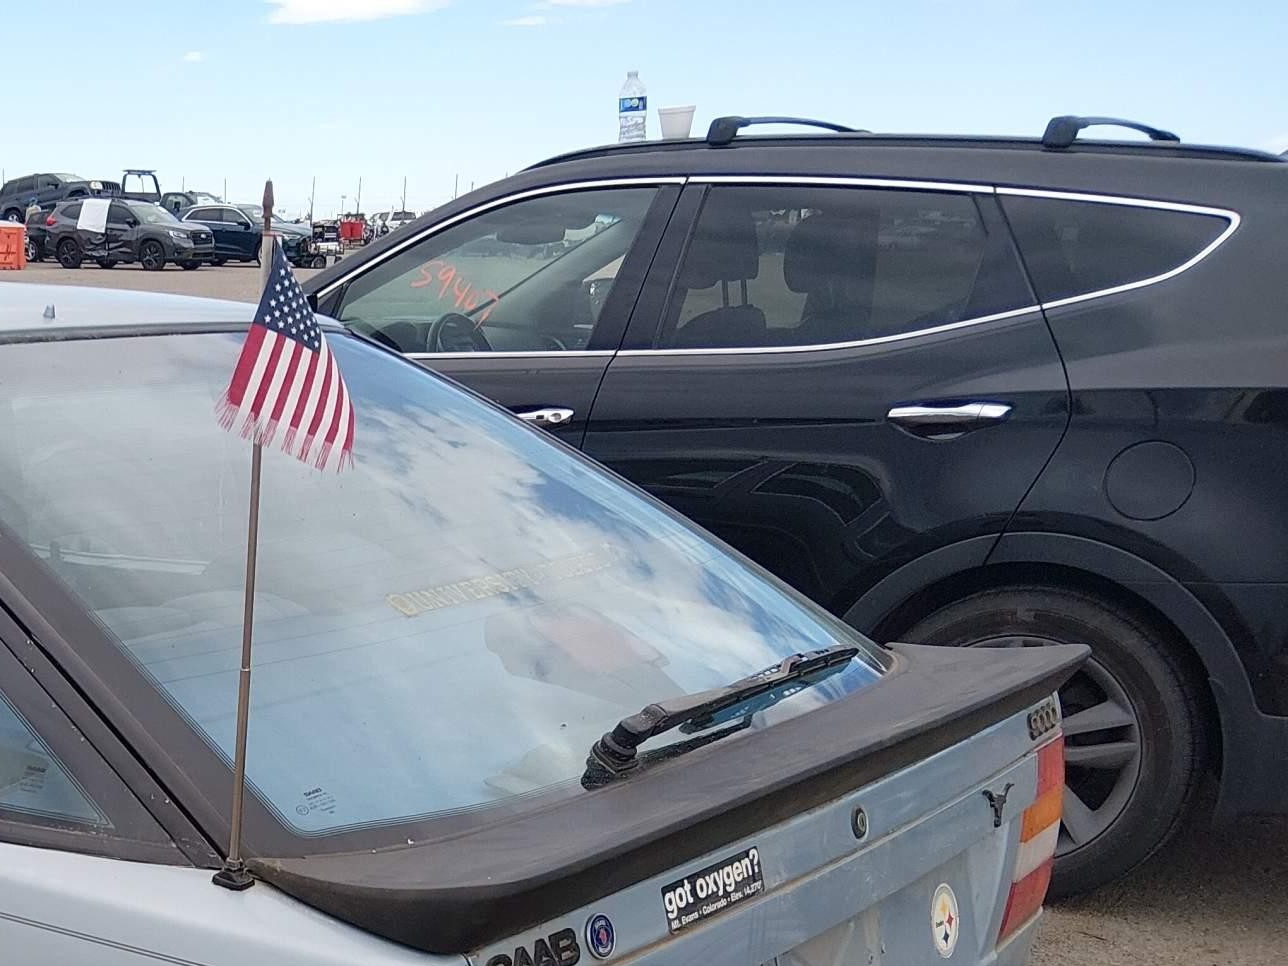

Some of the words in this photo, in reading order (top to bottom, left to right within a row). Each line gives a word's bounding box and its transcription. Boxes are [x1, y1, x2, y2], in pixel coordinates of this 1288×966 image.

[1027, 703, 1058, 741] 9000
[664, 879, 694, 919] got
[696, 848, 759, 898] oxygen?
[671, 919, 682, 930] Mt.
[681, 910, 699, 926] Evans
[702, 897, 728, 915] Colorado
